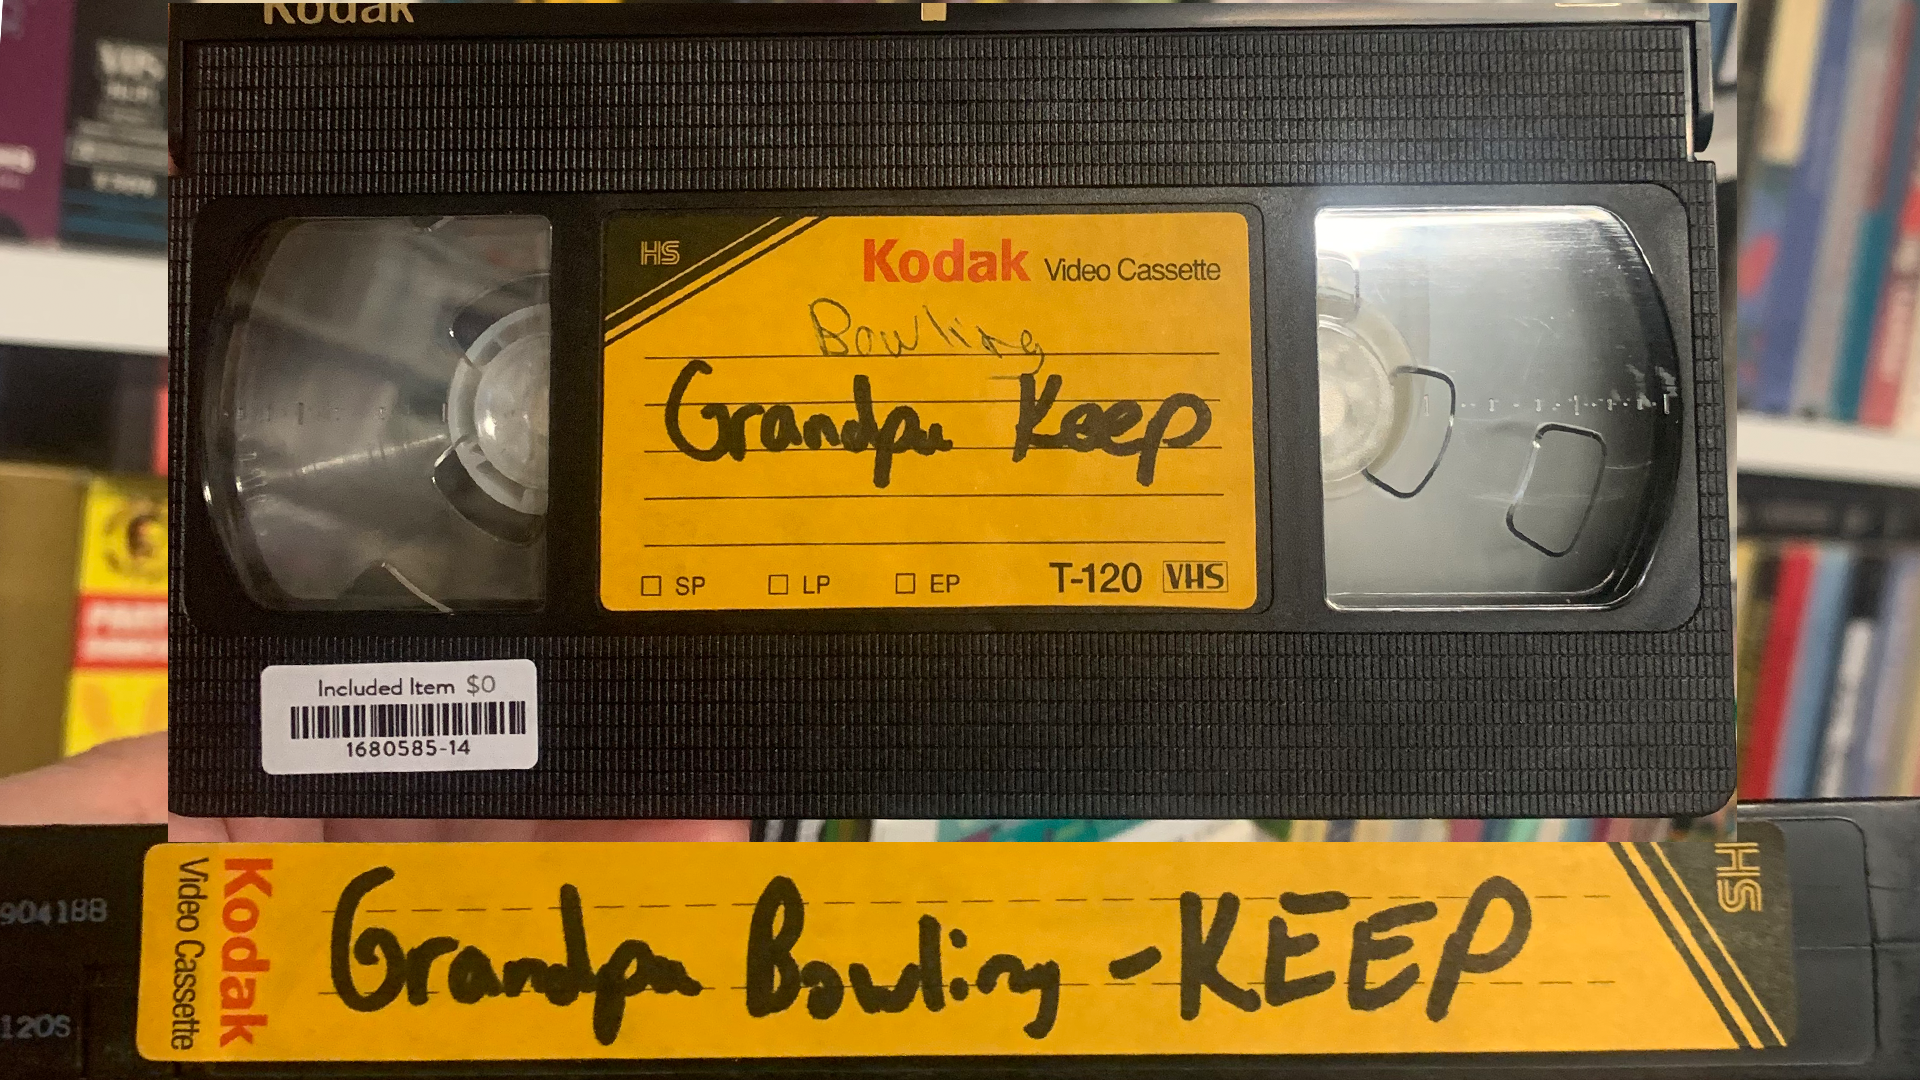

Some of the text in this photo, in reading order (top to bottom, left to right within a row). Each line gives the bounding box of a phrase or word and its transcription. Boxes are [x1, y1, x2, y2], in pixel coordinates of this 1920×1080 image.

[863, 238, 1222, 284] Kodak Video Cassette
[808, 298, 1045, 375] Bowling
[665, 359, 1212, 488] Grandpa Keep
[675, 576, 706, 597] SP
[803, 574, 831, 595] LP
[930, 573, 961, 594] EP
[1049, 562, 1227, 594] T-120 VHS
[318, 673, 496, 698] Included Item $0
[346, 739, 471, 758] 1680585-14
[171, 857, 210, 1051] Video Cassette
[219, 857, 274, 1048] Kodak
[331, 866, 703, 1046] Grandpa
[745, 875, 1061, 1039] Bowling
